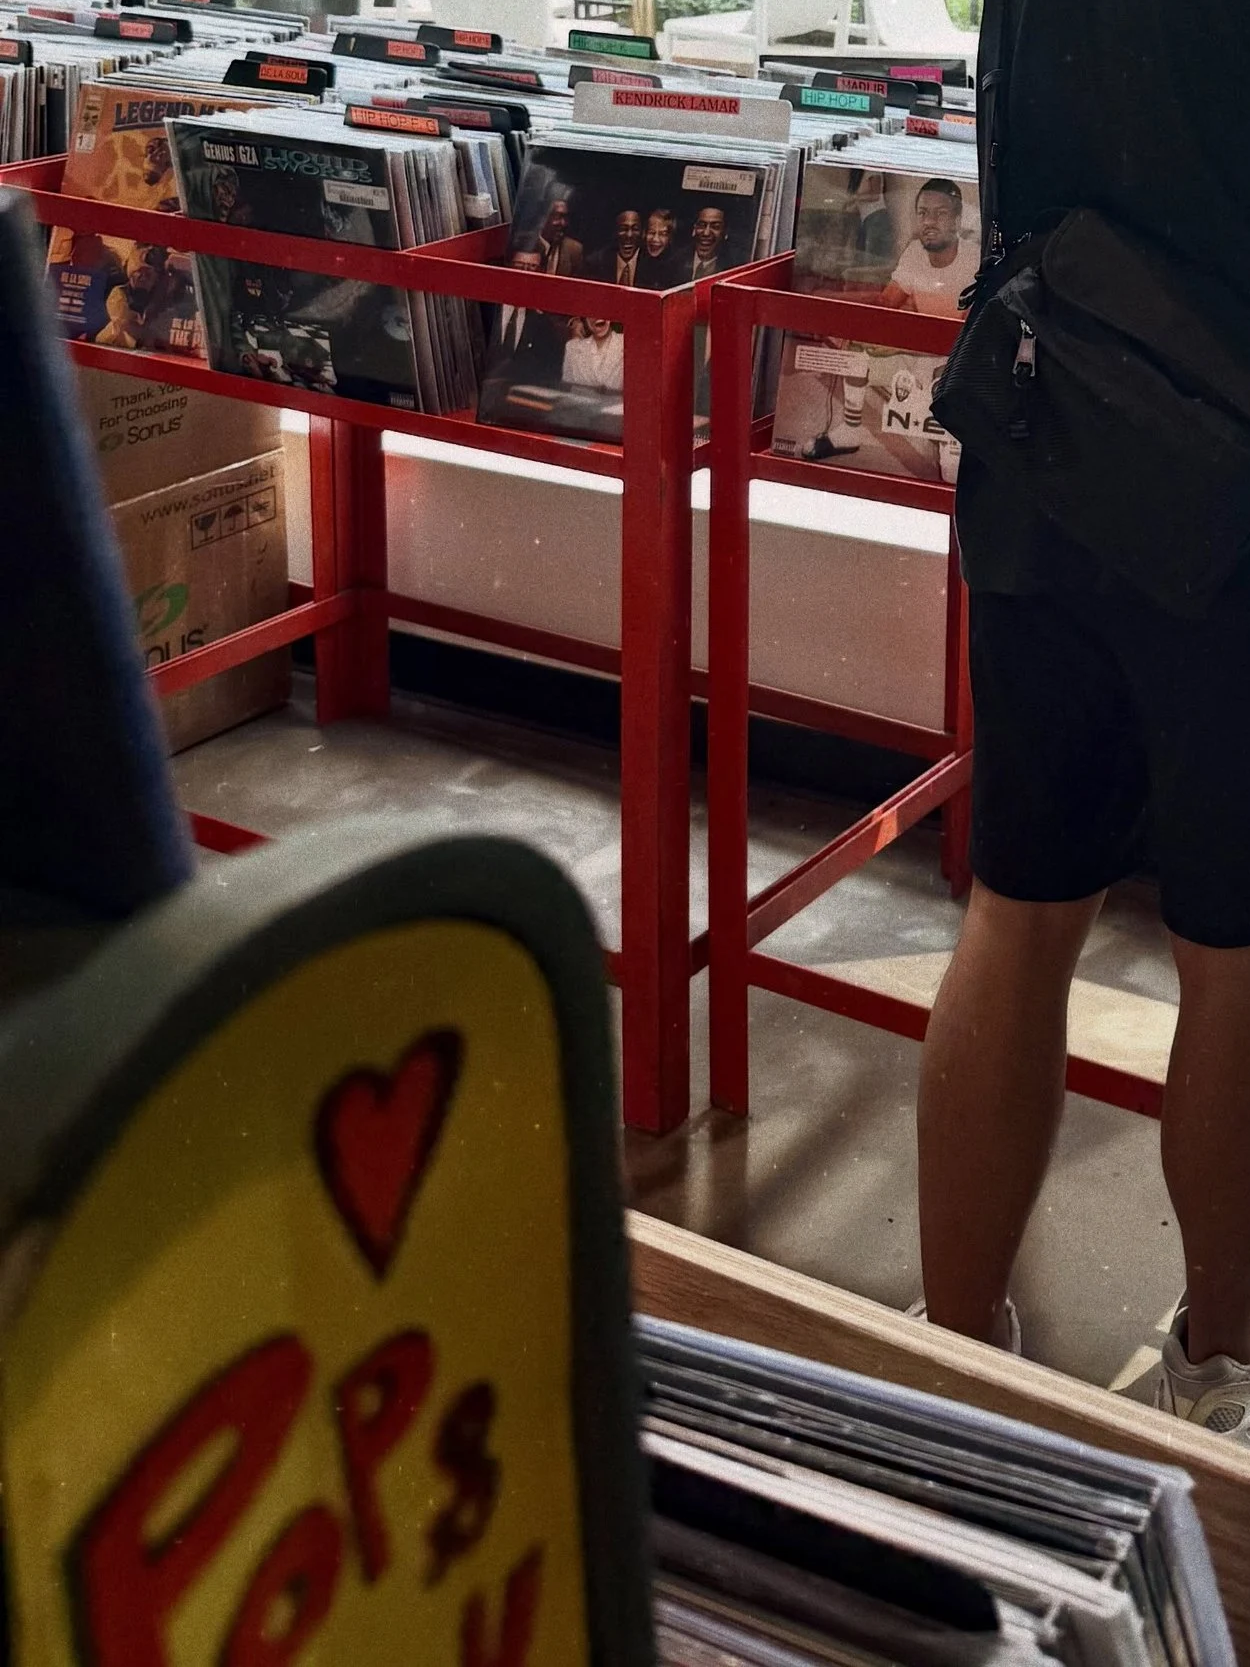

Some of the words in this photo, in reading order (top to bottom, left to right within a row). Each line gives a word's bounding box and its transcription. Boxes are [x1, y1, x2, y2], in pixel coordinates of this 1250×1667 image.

[615, 91, 687, 110] KENDRICK
[690, 97, 739, 114] LAMAR
[804, 91, 826, 105] HIP
[829, 94, 857, 108] HOP
[353, 108, 375, 122] HIP
[380, 112, 407, 127] HOP
[906, 118, 939, 137] NAS
[111, 389, 154, 410] Thank
[100, 414, 123, 431] For
[126, 395, 189, 423] Choosing
[127, 416, 182, 445] Sonus
